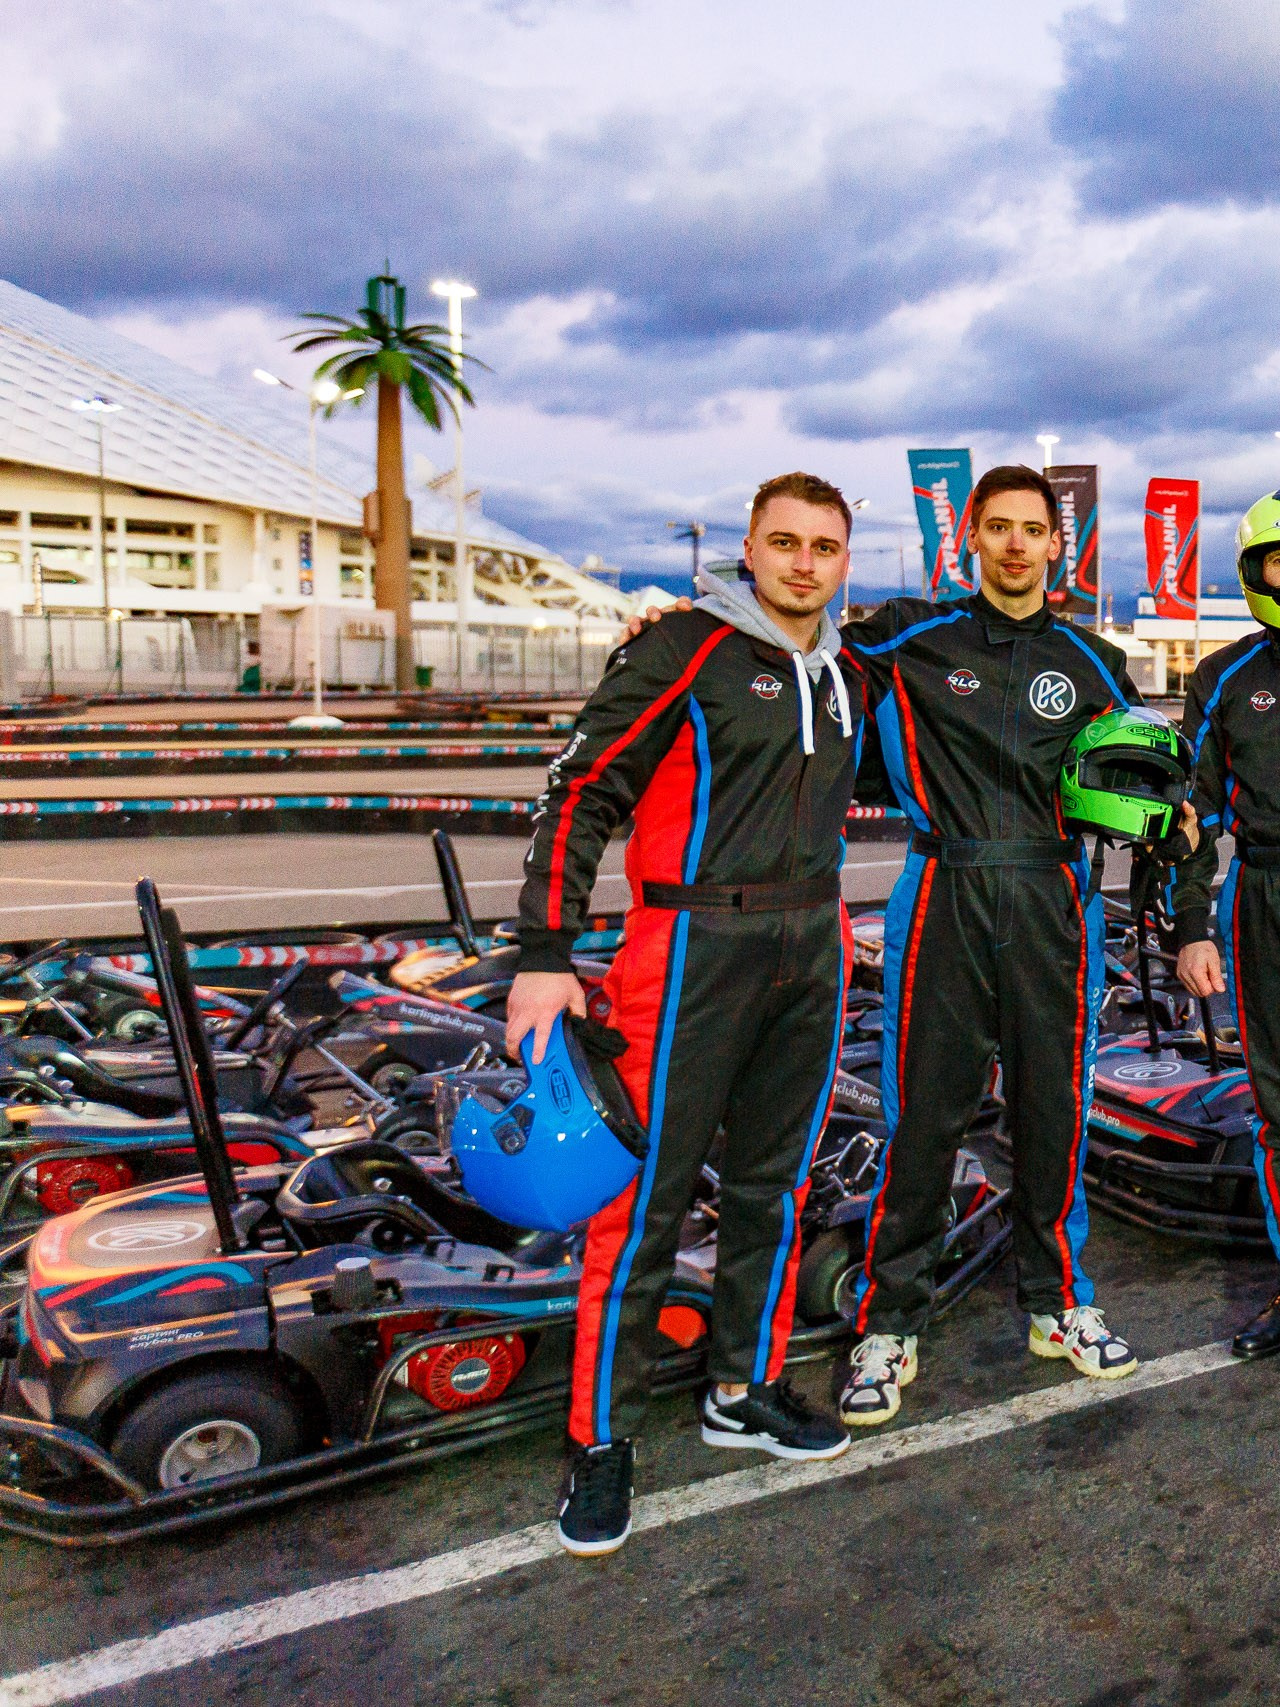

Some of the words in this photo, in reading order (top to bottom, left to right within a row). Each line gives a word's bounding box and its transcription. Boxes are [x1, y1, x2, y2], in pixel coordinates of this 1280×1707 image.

[752, 683, 783, 692] RLG
[948, 676, 981, 689] RLG
[1250, 697, 1277, 705] RLG
[836, 1082, 880, 1107] club.pro
[176, 1331, 204, 1341] PRO
